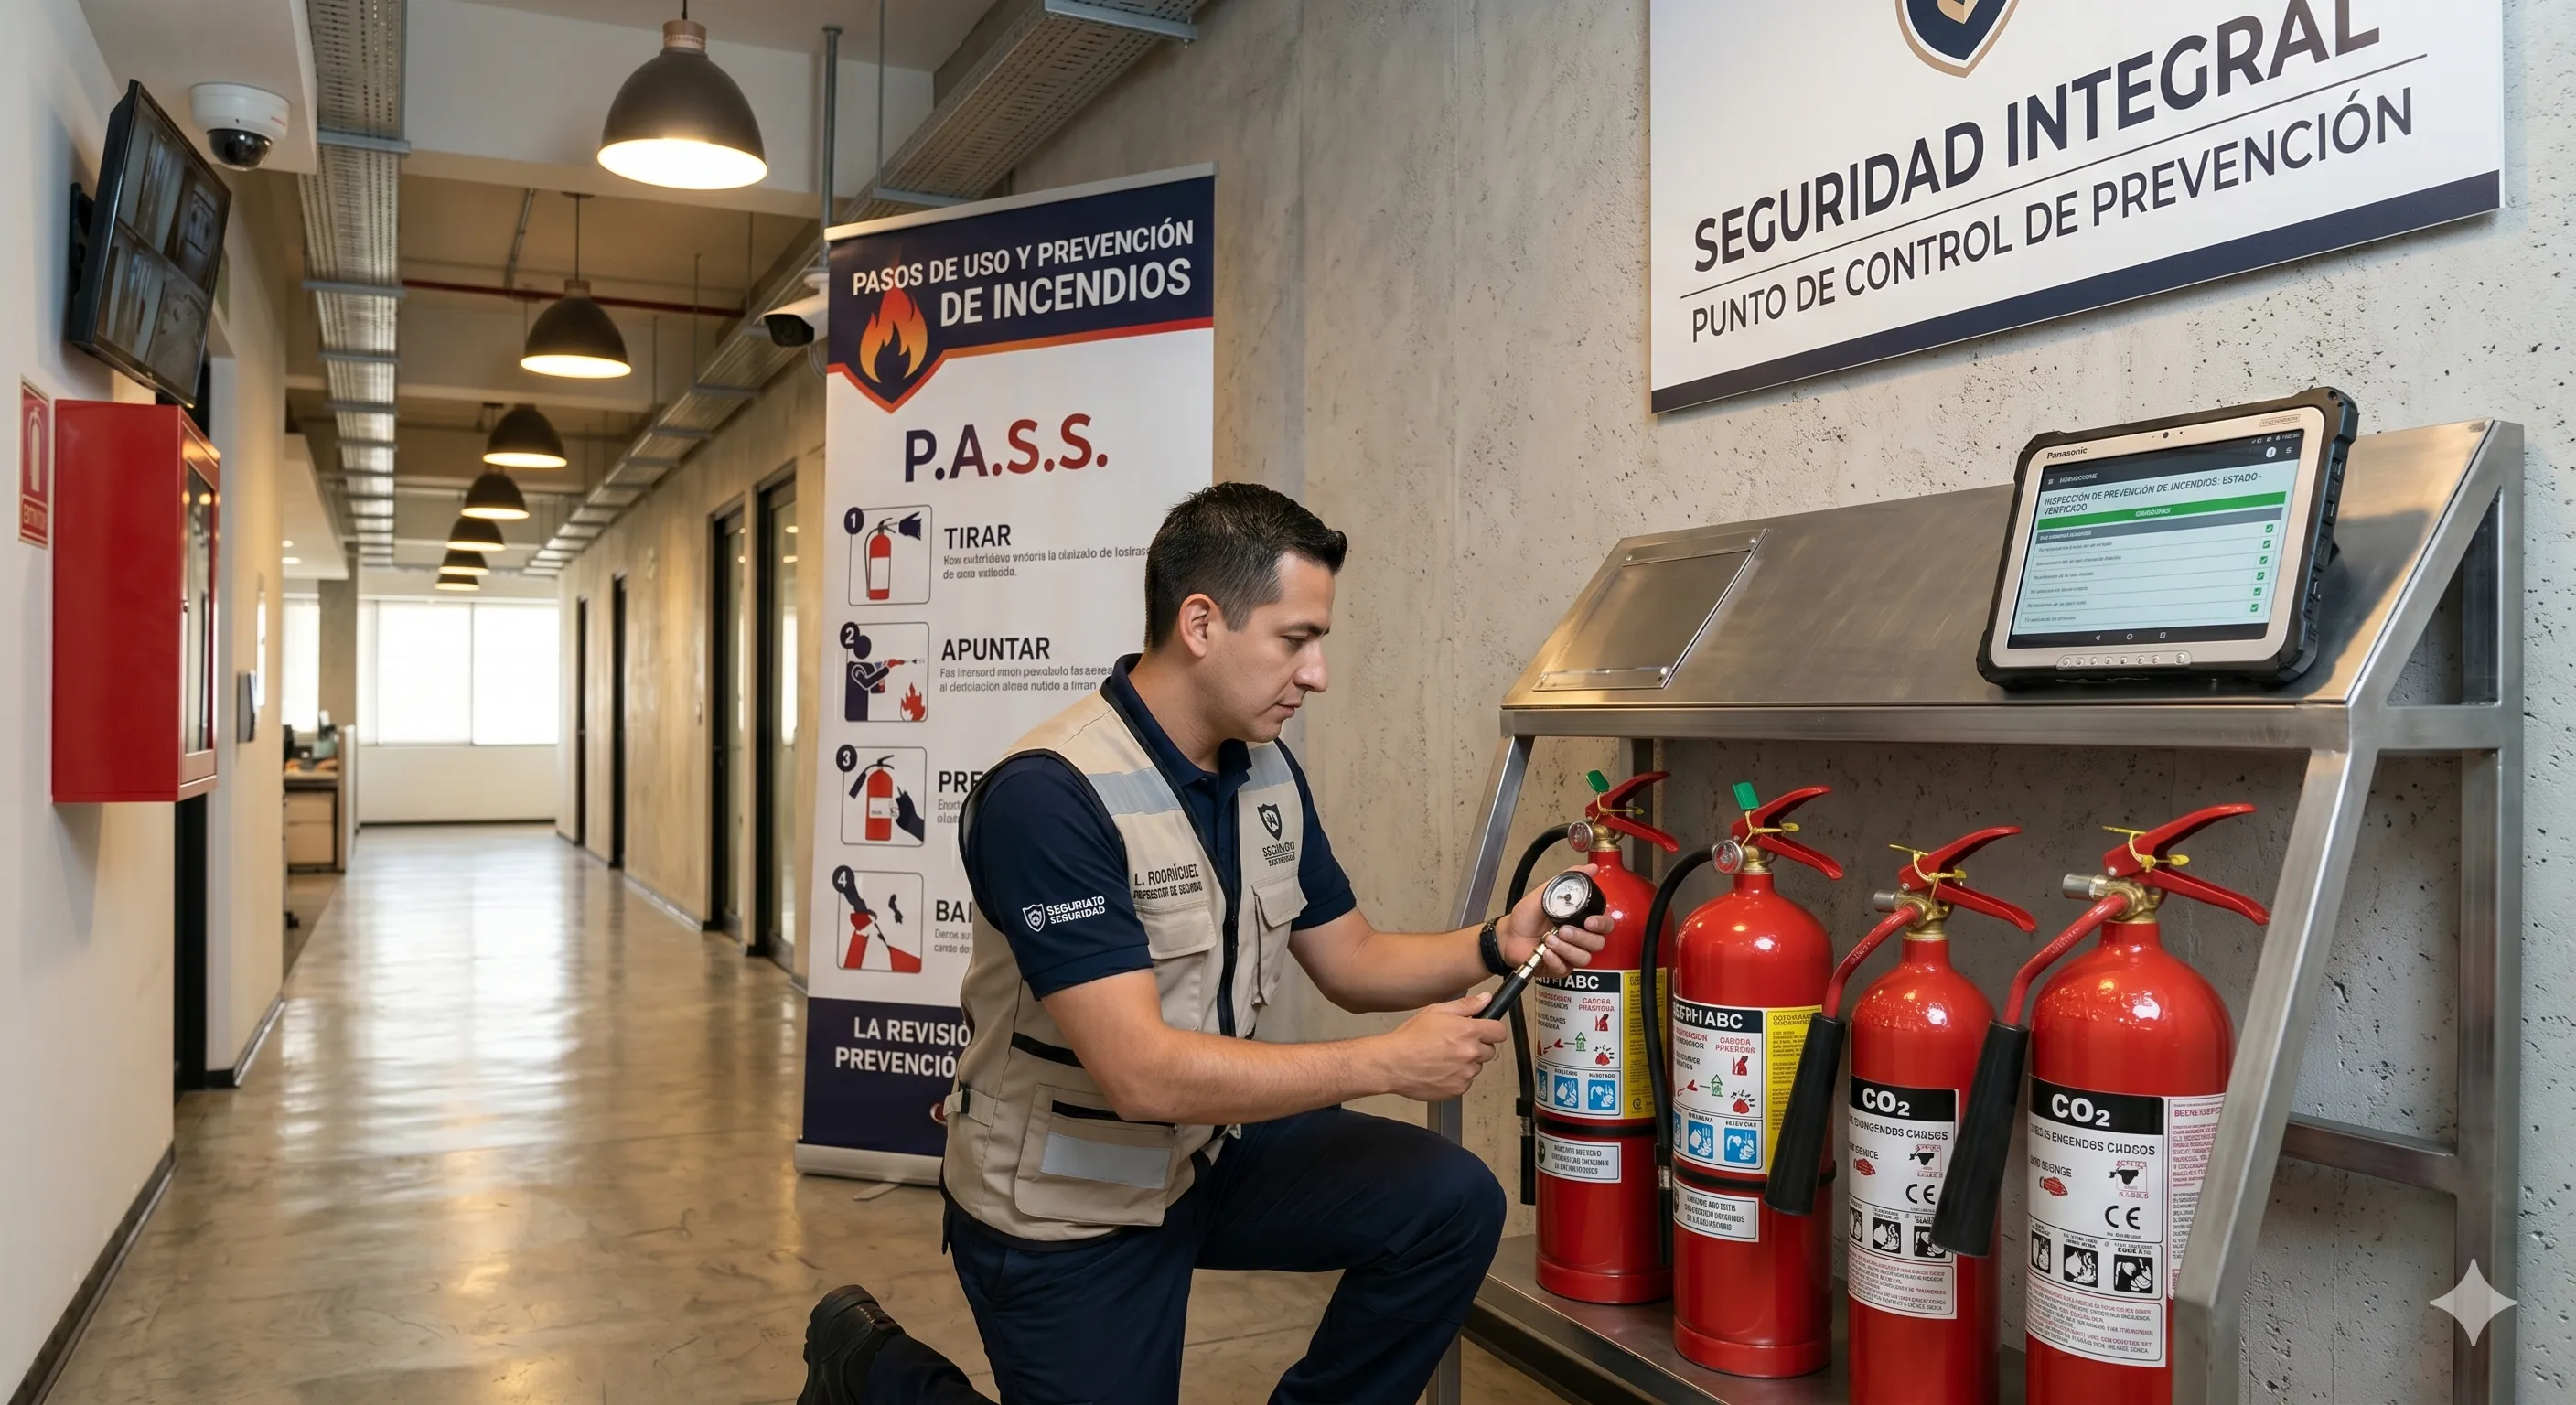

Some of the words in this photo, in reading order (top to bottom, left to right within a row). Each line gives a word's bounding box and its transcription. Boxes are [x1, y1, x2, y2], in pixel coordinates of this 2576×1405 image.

[1694, 122, 1984, 273] SEGURIDAD
[2007, 0, 2380, 168] INTEGRAL
[1692, 284, 1787, 343] PUNTO
[1796, 267, 1836, 313] DE
[1845, 215, 2013, 296] CONTROL
[2025, 190, 2078, 247] DE
[2093, 86, 2412, 227] PREVENCIÓN
[853, 263, 923, 296] PASOS
[929, 256, 958, 284] DE
[964, 249, 1010, 278] USO
[1015, 244, 1032, 270] Y
[1038, 217, 1194, 267] PREVENCIÓN
[940, 286, 983, 327] DE
[993, 257, 1192, 320] INCENDIOS
[904, 413, 1109, 483] P.A.S.S.
[2046, 446, 2088, 459] Panasonic
[2104, 485, 2155, 499] PREVENCIÓN
[849, 512, 857, 529] 1
[944, 524, 1012, 550] TIRAR
[1100, 547, 1113, 558] de
[844, 627, 855, 645] 2
[940, 637, 1050, 661] APUNTAR
[843, 750, 851, 767] 3
[837, 871, 847, 887] 4
[1134, 873, 1145, 886] L.
[1564, 974, 1599, 990] ABC
[853, 1016, 881, 1040] LA
[1704, 1011, 1744, 1029] ABC
